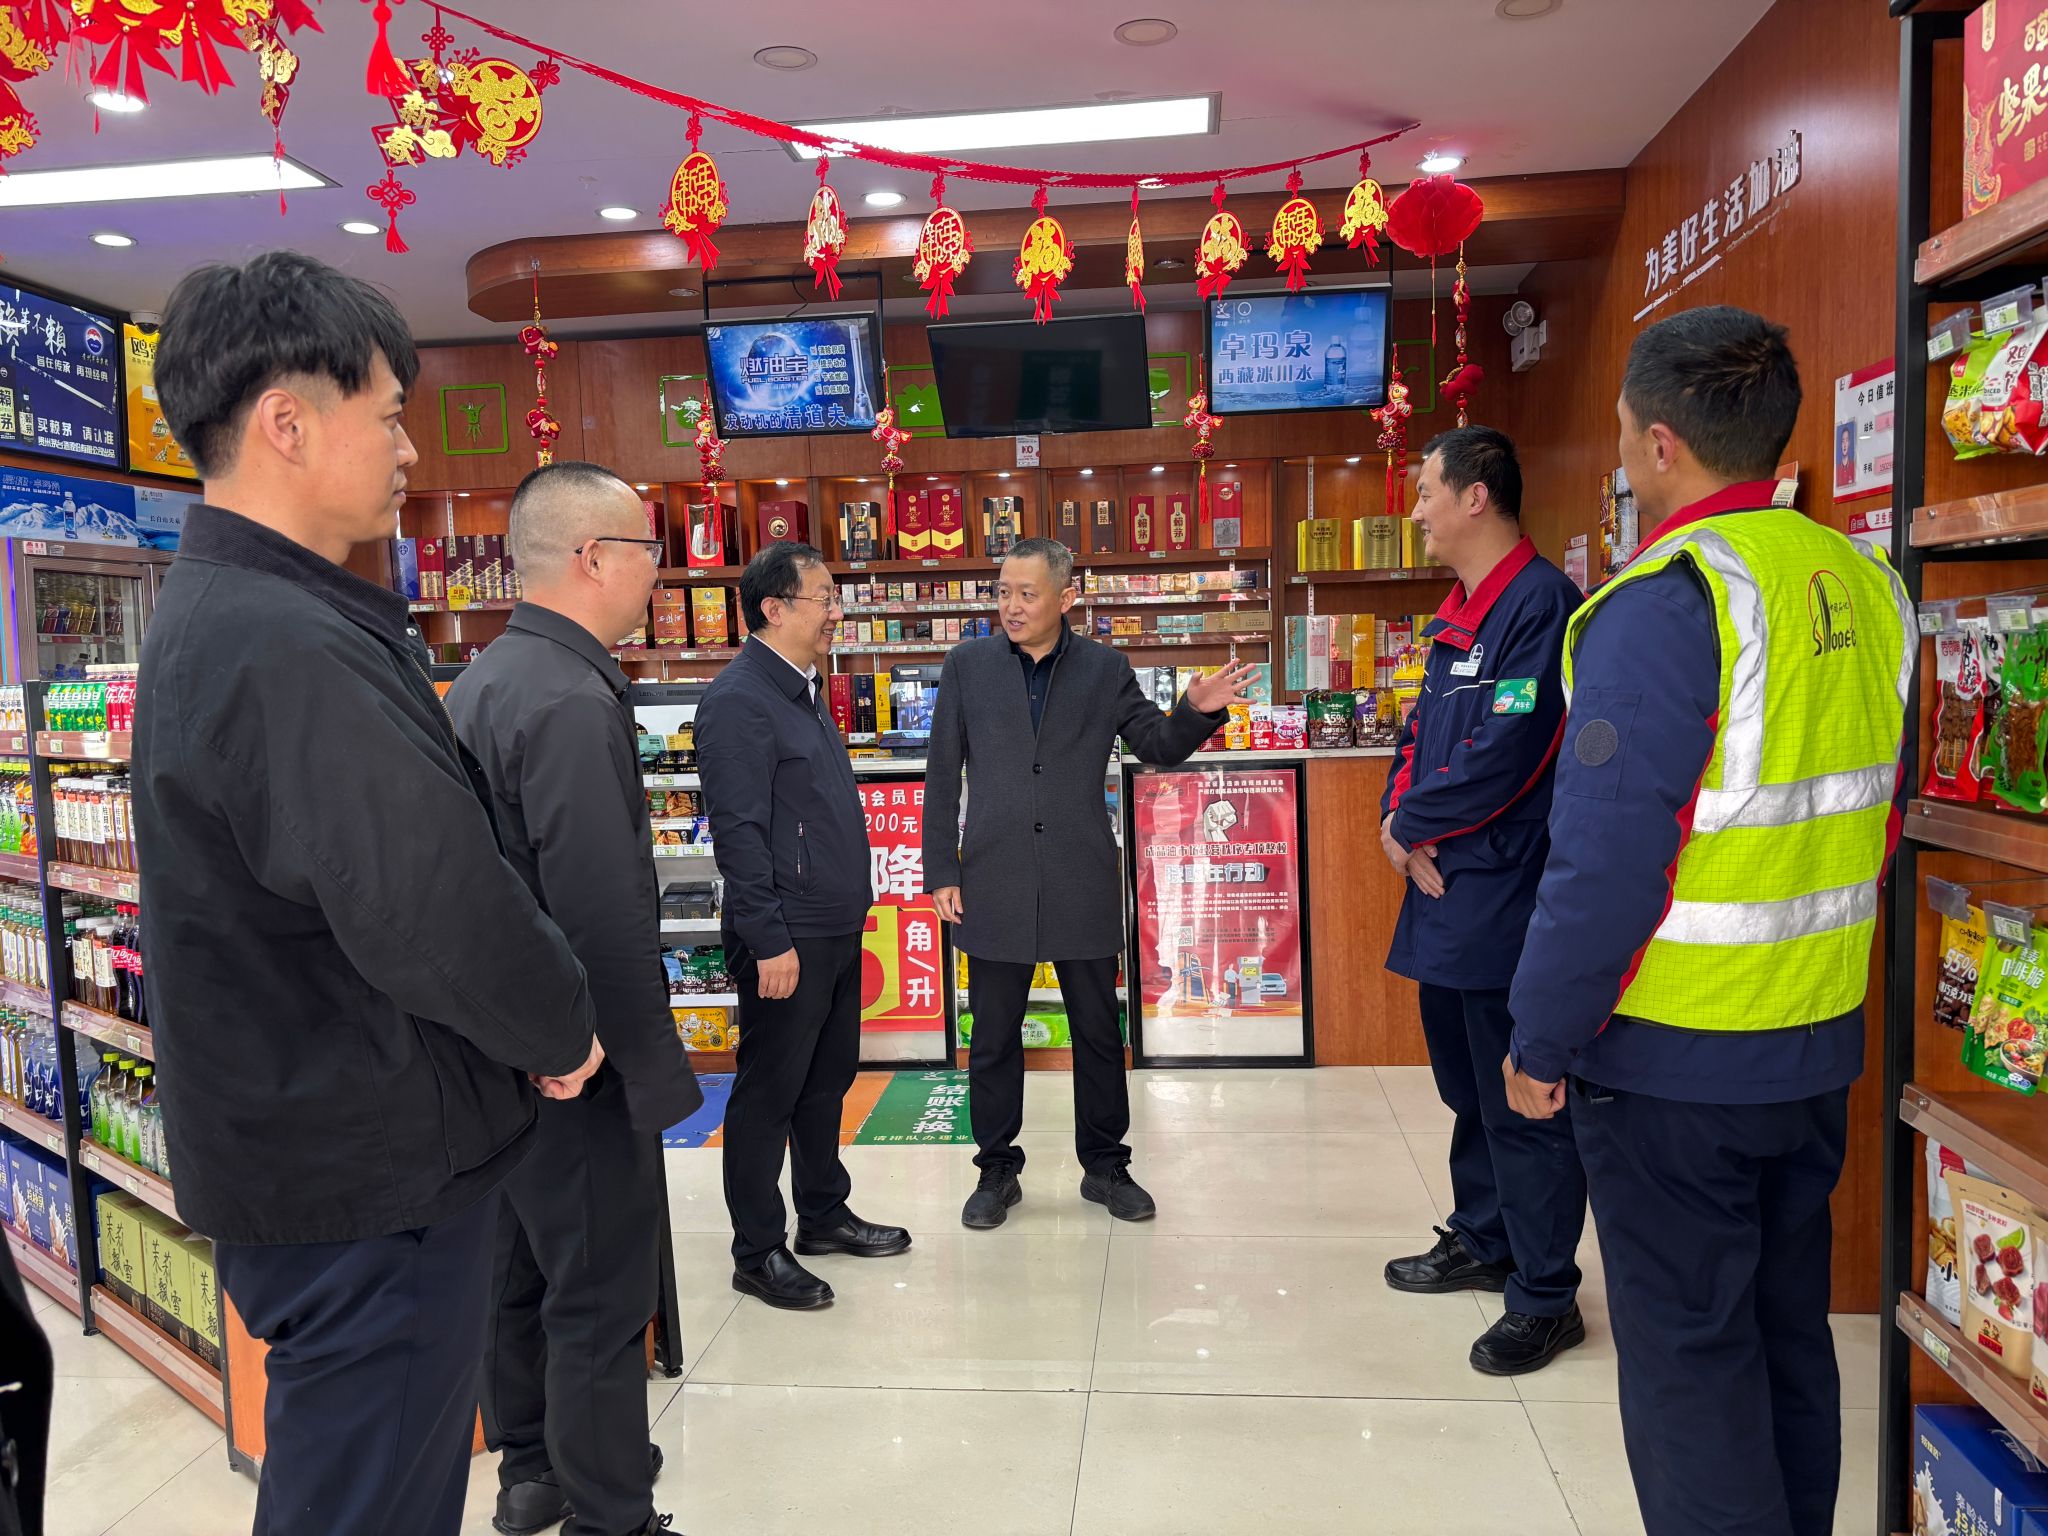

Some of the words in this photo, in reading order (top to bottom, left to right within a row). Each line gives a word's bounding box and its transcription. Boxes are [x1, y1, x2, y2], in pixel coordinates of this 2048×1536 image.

[476, 67, 539, 142] 福
[1997, 62, 2048, 147] 坚果
[1645, 129, 1802, 298] 为美好生活加油
[1218, 330, 1313, 361] 卓玛泉
[740, 353, 809, 378] 燃油宝
[1218, 364, 1314, 384] 西藏冰川水
[1858, 380, 1894, 406] 今日值班
[725, 403, 848, 430] 发动机的清道夫
[82, 425, 115, 445] 请认准
[870, 844, 923, 902] 降
[1943, 947, 1978, 982] 55%
[873, 1134, 974, 1143] 请排队办理业
